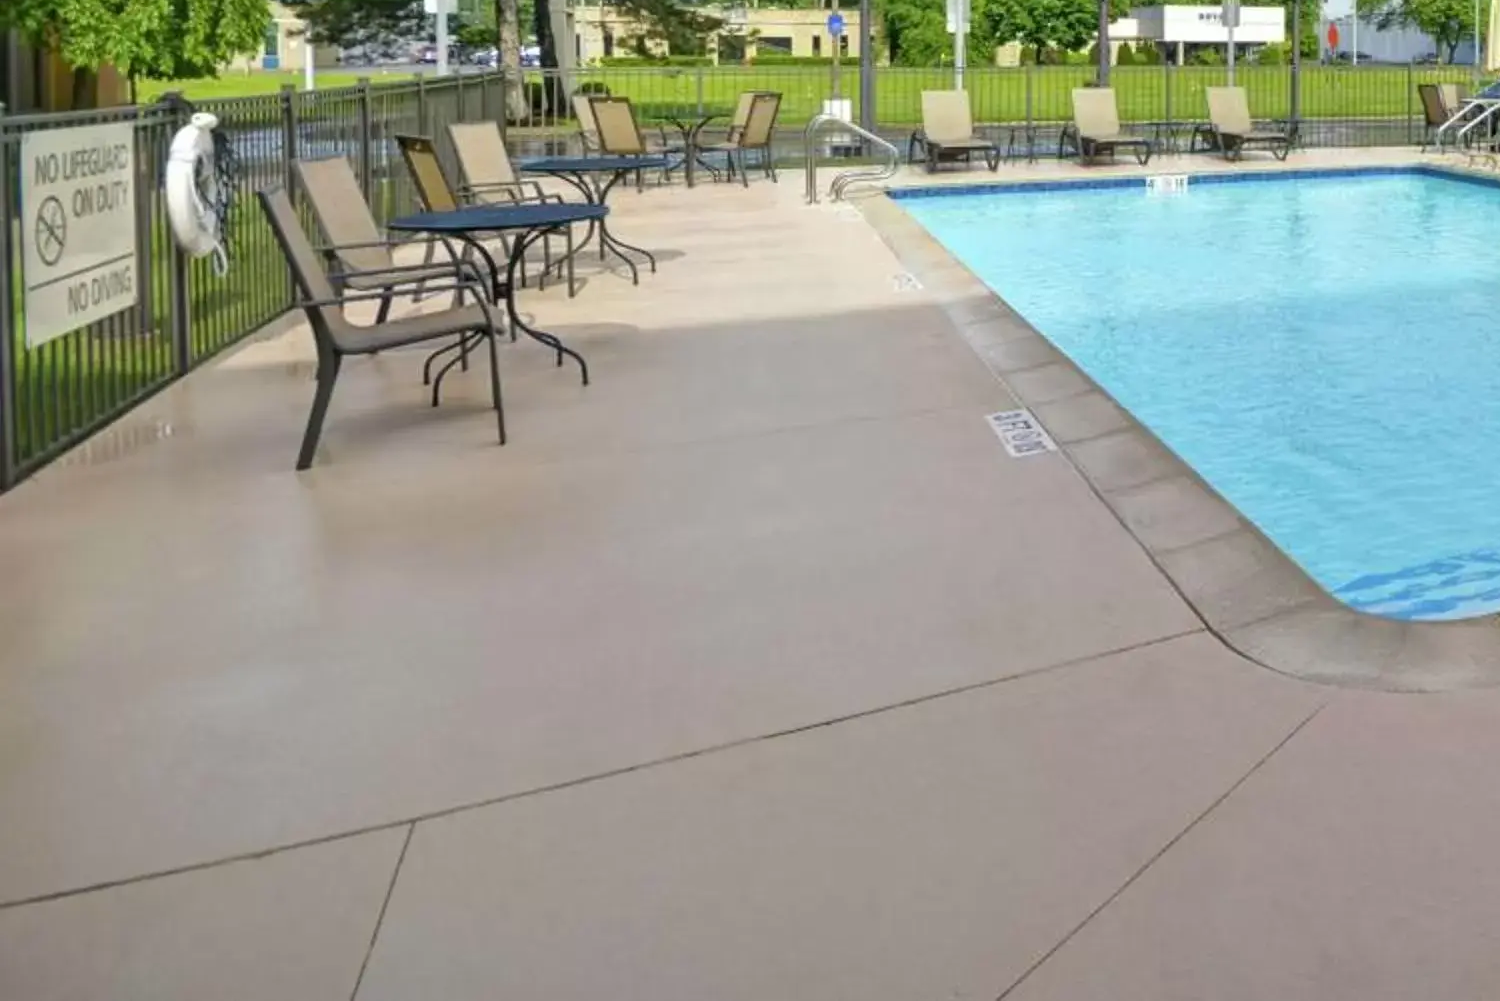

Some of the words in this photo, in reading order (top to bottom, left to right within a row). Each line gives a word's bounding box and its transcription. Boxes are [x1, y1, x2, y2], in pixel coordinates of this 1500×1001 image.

[35, 153, 59, 186] NO
[62, 143, 128, 181] LIFEGUARD
[72, 186, 94, 218] ON
[97, 180, 128, 213] DUTY
[67, 281, 89, 314] NO
[91, 265, 132, 306] DIVING
